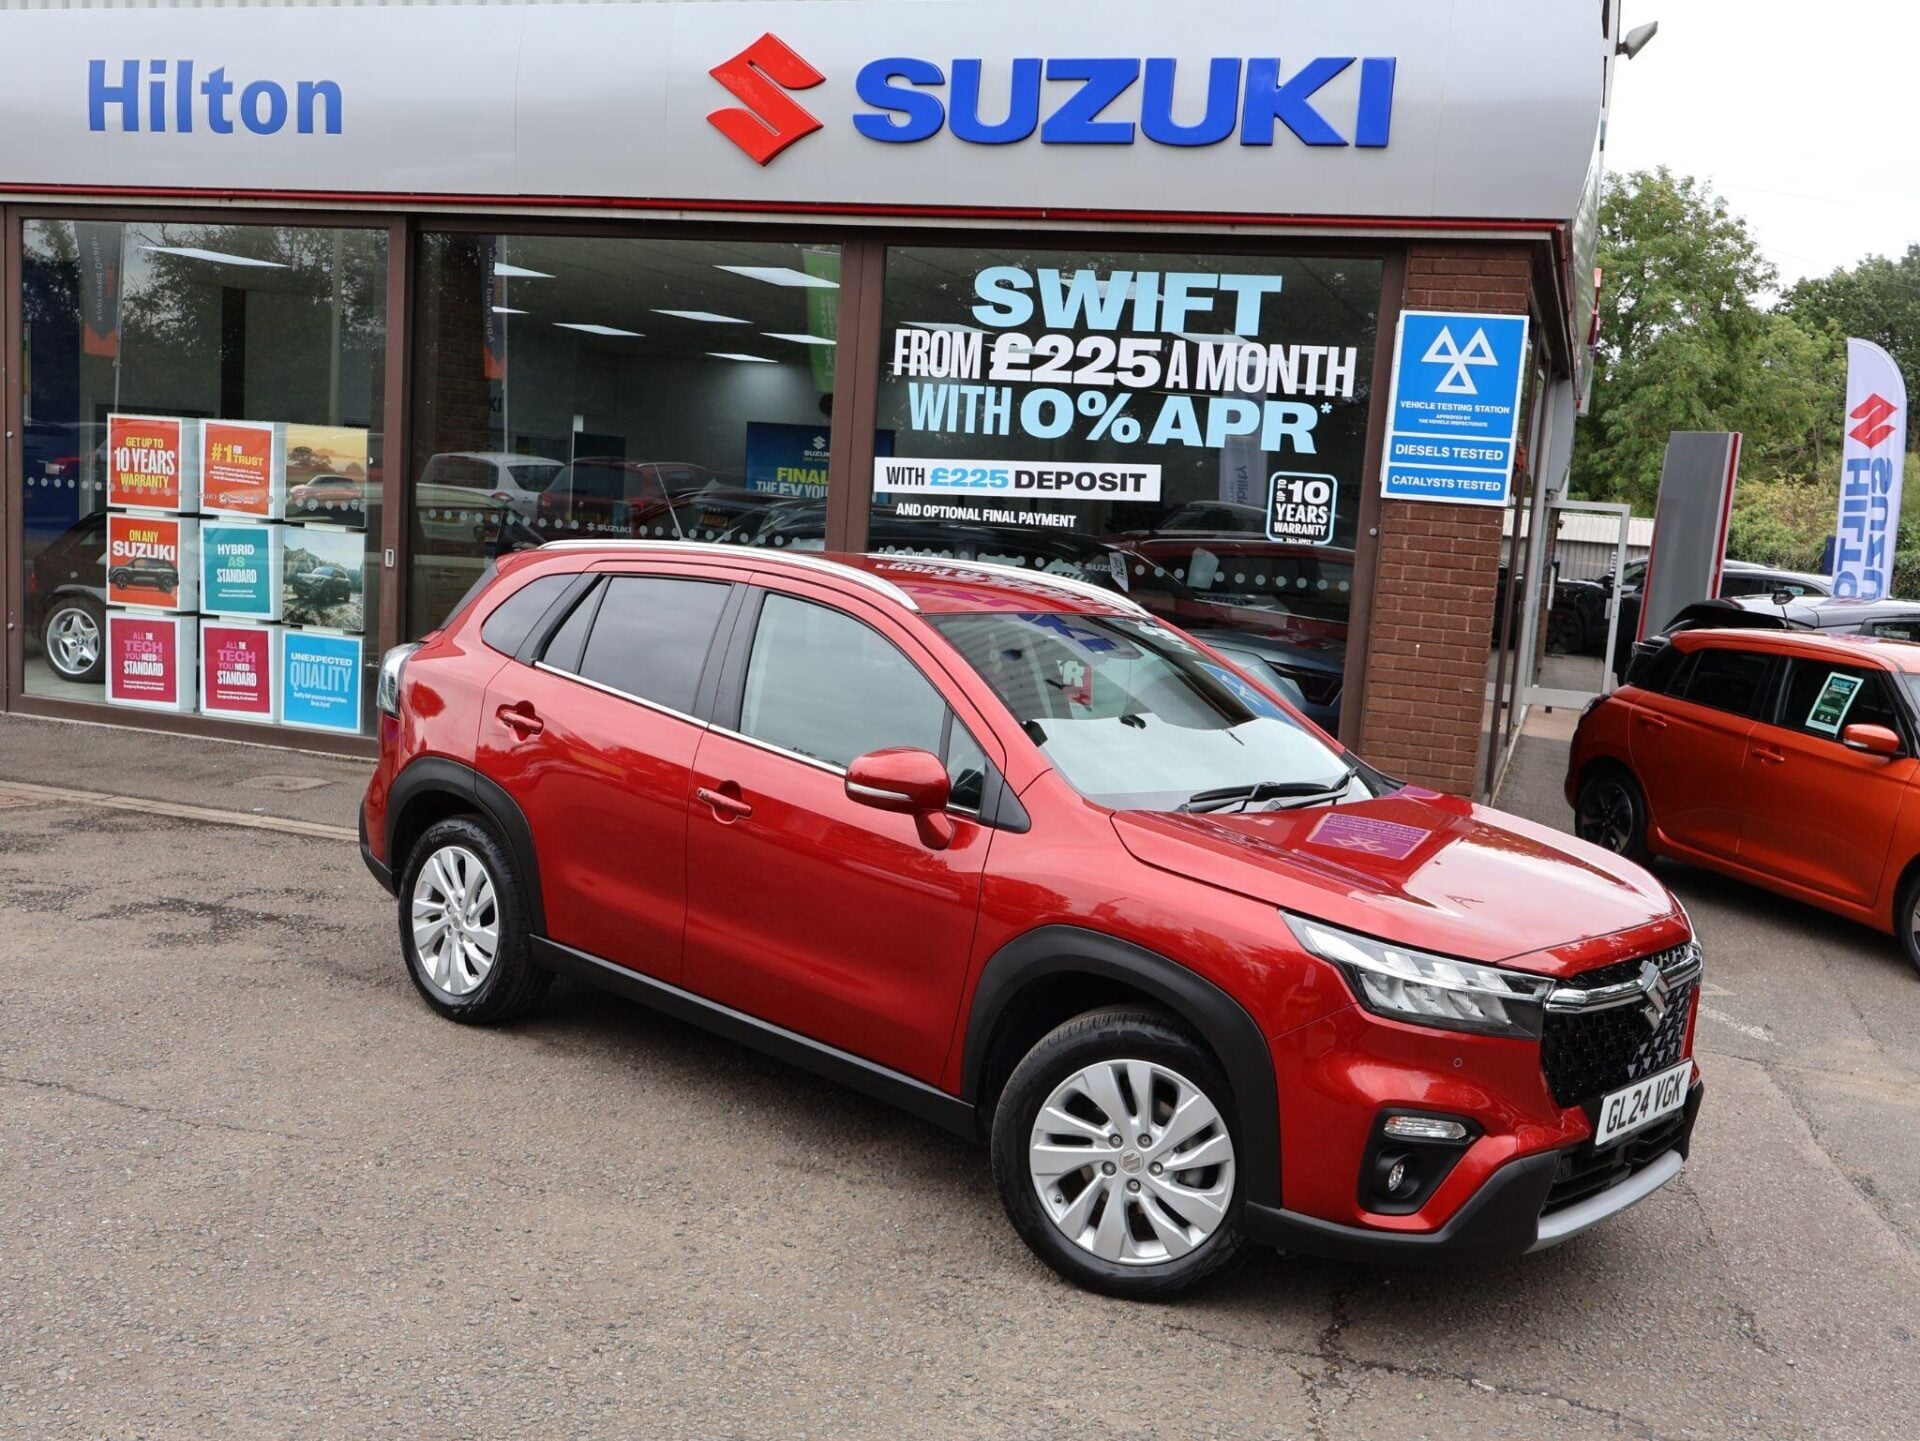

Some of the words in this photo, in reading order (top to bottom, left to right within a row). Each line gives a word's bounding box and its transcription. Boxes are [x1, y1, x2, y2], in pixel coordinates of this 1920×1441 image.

[88, 58, 343, 135] Hilton
[852, 56, 1397, 148] SUZUKI
[972, 265, 1283, 337] SWIFT
[894, 329, 983, 380] FROM
[989, 332, 1162, 388] £225
[1165, 340, 1189, 389] A
[1196, 341, 1357, 398] MONTH
[909, 382, 1013, 436] WITH
[1020, 388, 1141, 444] 0%
[1400, 400, 1435, 411] VEHICLE
[1437, 402, 1472, 412] TESTING
[1474, 404, 1510, 414] STATION
[1450, 420, 1488, 428] INSPECTORATE
[126, 437, 140, 447] GET
[142, 438, 152, 448] UP
[153, 439, 164, 449] TO
[211, 442, 233, 463] #1
[1395, 444, 1450, 457] DIESELS
[1452, 447, 1504, 461] TESTED
[114, 447, 129, 472] 10
[132, 448, 175, 475] YEARS
[233, 455, 264, 467] TRUST
[120, 472, 169, 488] WARRANTY
[886, 465, 925, 486] WITH
[930, 467, 1009, 489] £225
[1014, 470, 1147, 492] DEPOSIT
[1277, 479, 1287, 489] TO
[1392, 475, 1454, 489] CATALYSTS
[1457, 479, 1501, 492] TESTED
[756, 480, 778, 493] THE
[779, 482, 803, 497] EV
[1276, 491, 1286, 502] UP
[1288, 480, 1330, 505] 10
[896, 502, 922, 517] AND
[923, 504, 981, 521] OPTIONAL
[982, 508, 1016, 524] FINAL
[1018, 510, 1076, 528] PAYMENT
[1276, 503, 1328, 524] YEARS
[129, 529, 141, 541] ON
[142, 530, 159, 543] ANY
[597, 524, 632, 533] SUZUKI
[1274, 521, 1327, 536] WARRANTY
[112, 540, 176, 561] SUZUKI
[217, 543, 255, 555] HYBRID
[227, 556, 246, 567] AS
[216, 568, 257, 584] STANDARD
[133, 632, 145, 640] ALL
[124, 640, 163, 653] TECH
[226, 641, 238, 650] ALL
[125, 652, 141, 660] YOU
[141, 653, 157, 661] NEED
[217, 649, 256, 663] TECH
[290, 652, 353, 667] UNEXPECTED
[123, 660, 164, 677] STANDARD
[218, 661, 234, 670] YOU
[234, 663, 250, 671] NEED
[217, 670, 257, 687] STANDARD
[289, 661, 352, 693] QUALITY
[1606, 1084, 1652, 1134] GL24
[1654, 1069, 1686, 1112] VGK
